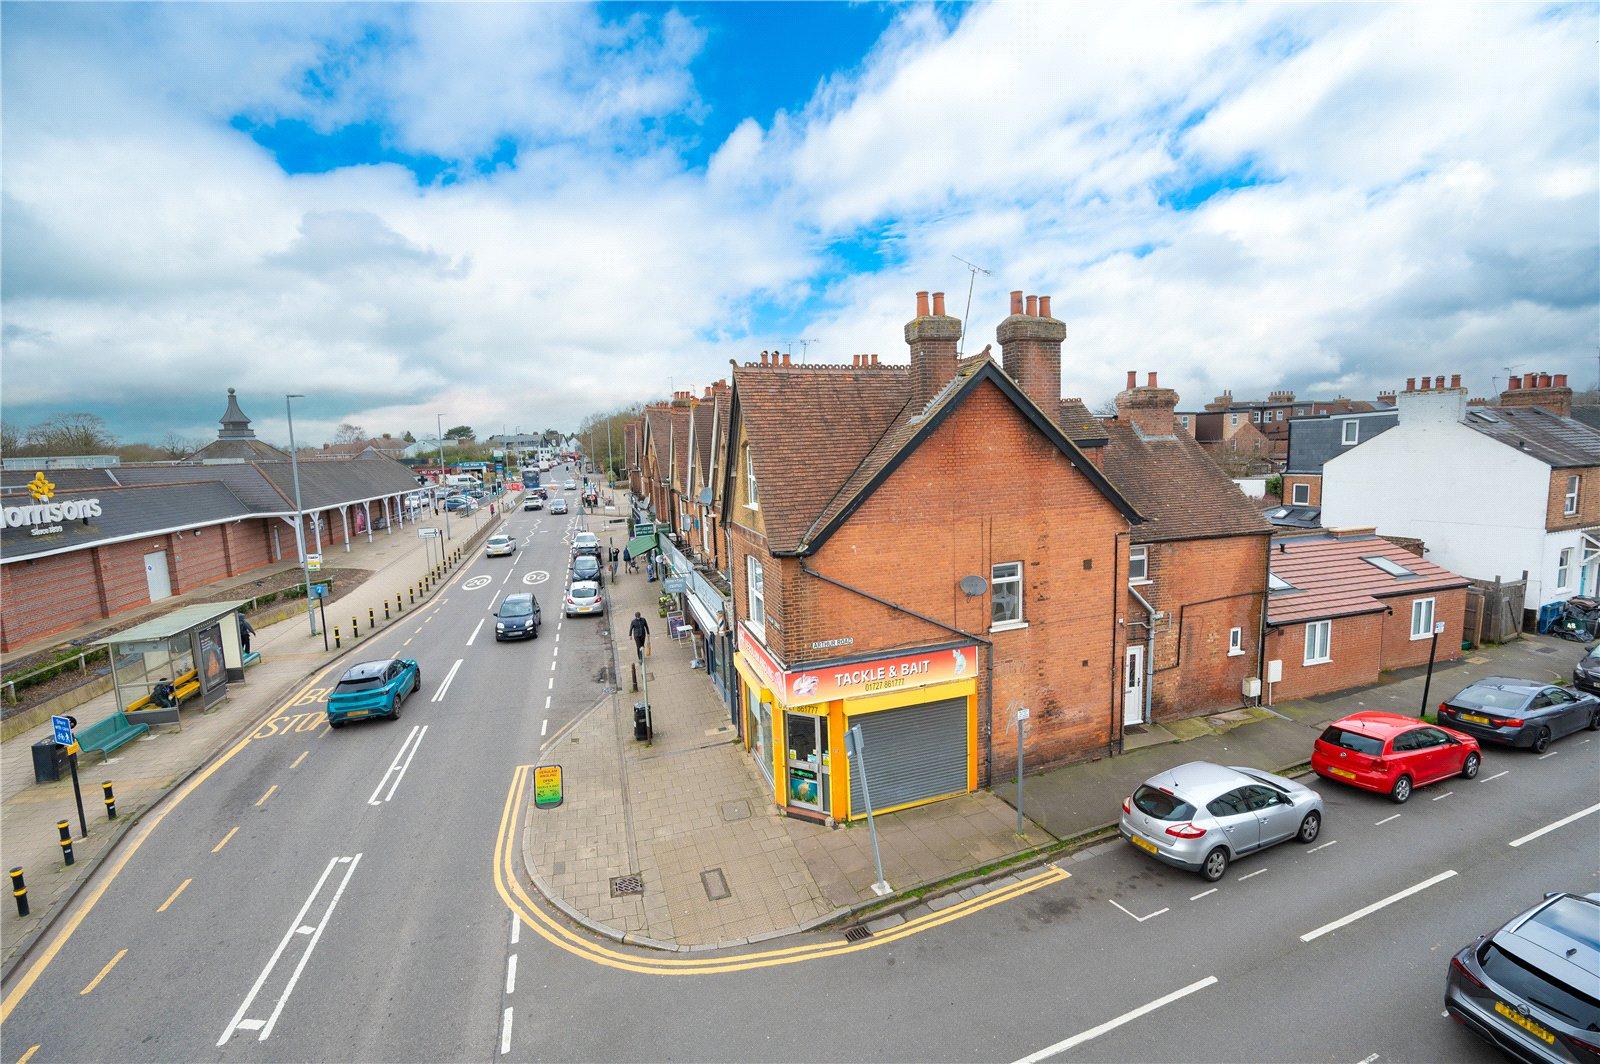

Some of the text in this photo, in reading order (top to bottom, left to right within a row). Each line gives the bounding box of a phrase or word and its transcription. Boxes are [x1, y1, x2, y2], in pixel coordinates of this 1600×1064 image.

[813, 637, 853, 649] ARTHUR ROAD
[835, 660, 931, 687] TACKLE & BAIT
[865, 678, 905, 692] 01727 861777
[293, 687, 334, 706] BU
